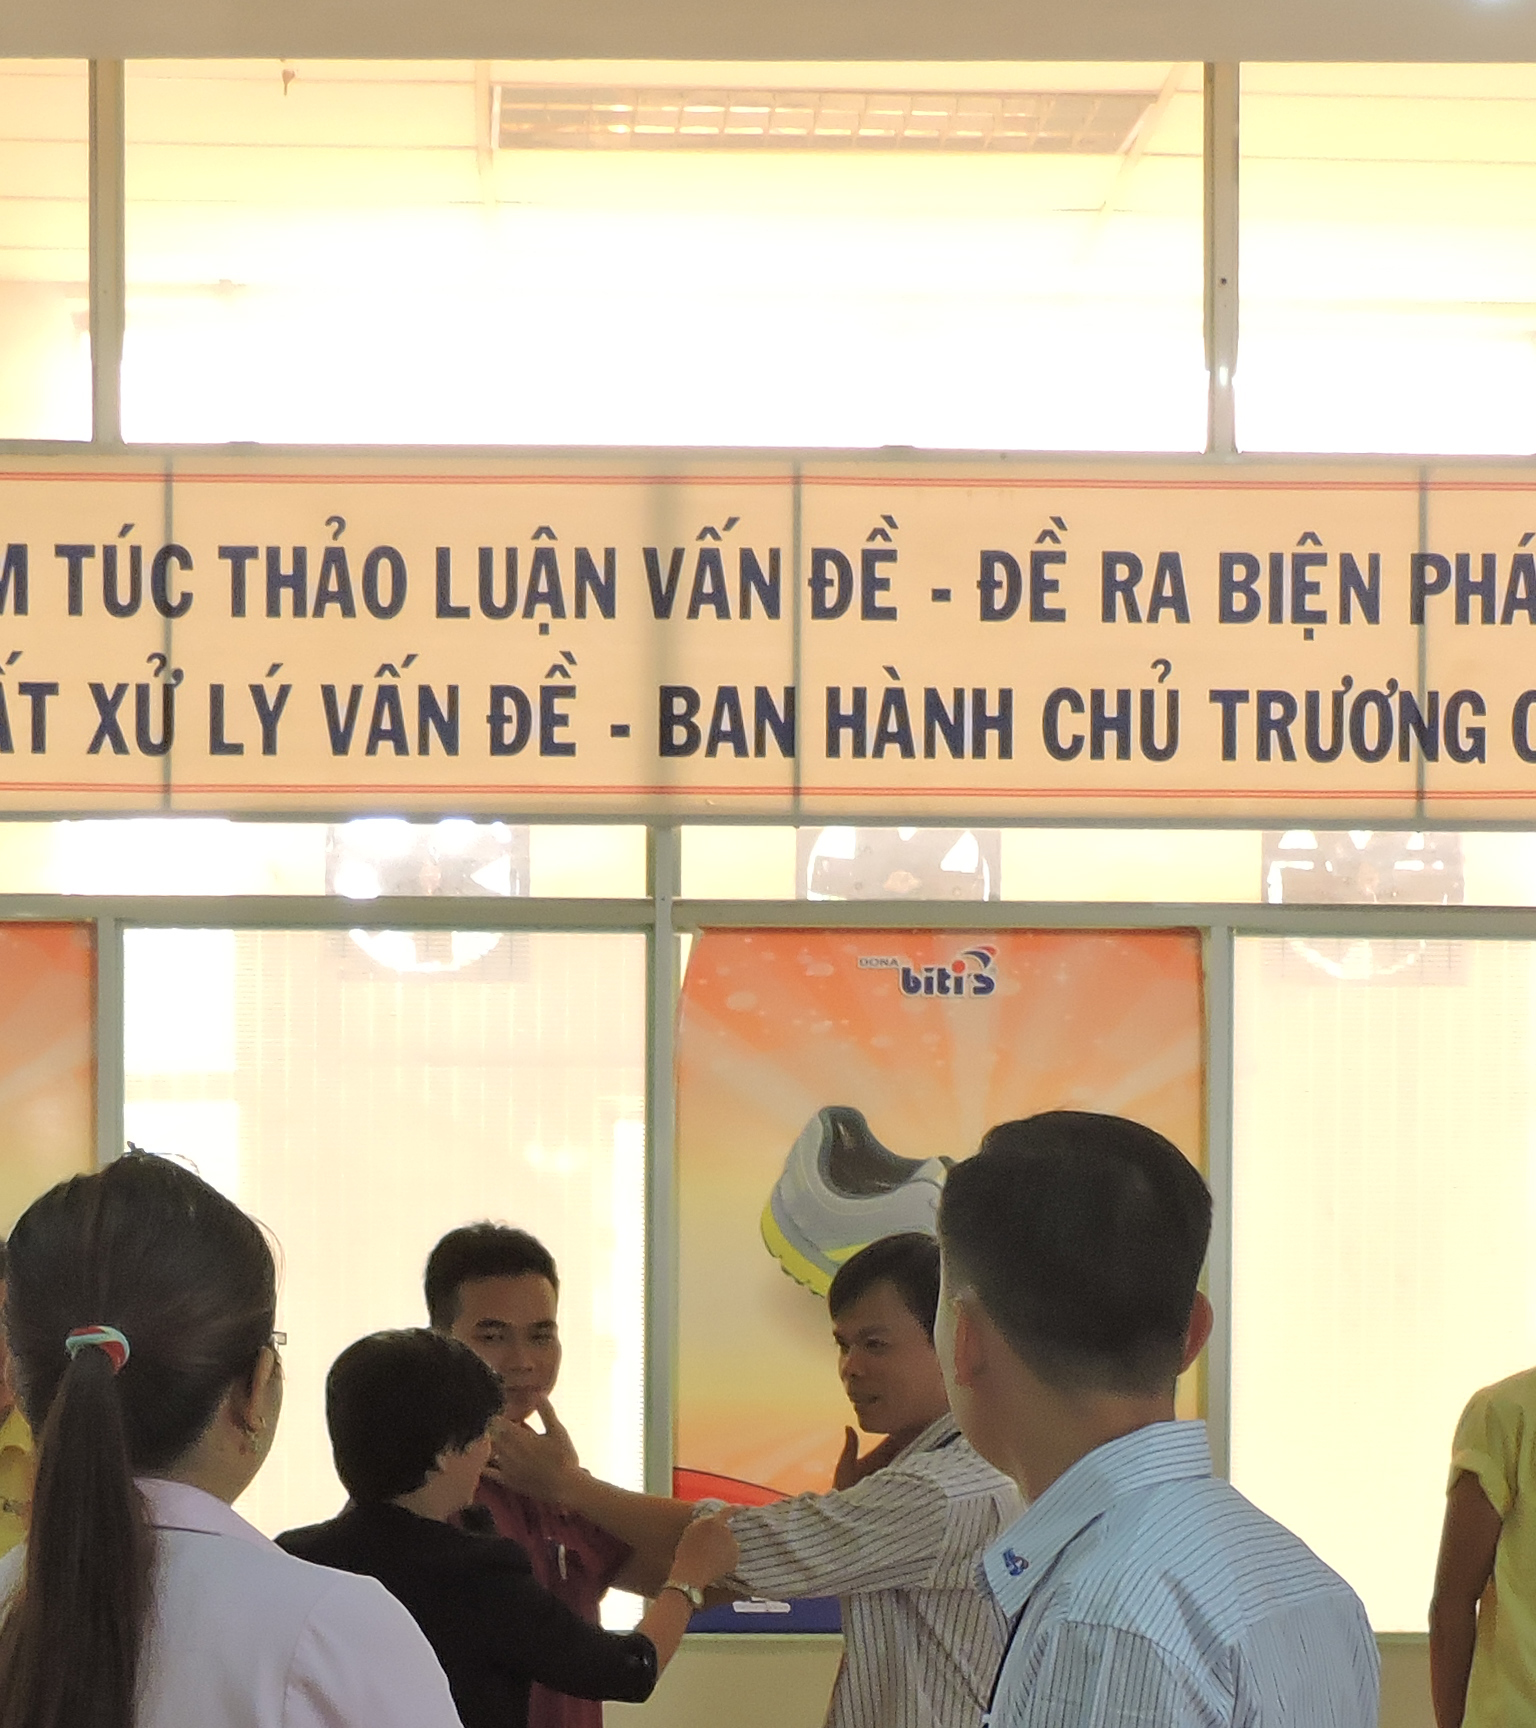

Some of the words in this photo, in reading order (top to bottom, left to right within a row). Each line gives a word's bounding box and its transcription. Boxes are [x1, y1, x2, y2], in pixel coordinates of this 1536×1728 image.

[54, 521, 194, 619] TÚC
[218, 516, 408, 618] THẢO
[436, 525, 617, 634] LUẬN
[644, 516, 782, 619] VẤN
[808, 514, 899, 620] ĐỀ
[976, 515, 1068, 622] ĐỀ
[1102, 552, 1191, 623] RA
[1219, 531, 1381, 641] BIỆN
[88, 652, 184, 757] XỬ
[209, 661, 293, 756] LÝ
[320, 653, 460, 757] VẤN
[486, 651, 578, 757] ĐỀ
[658, 684, 797, 758] BAN
[826, 665, 1014, 760] HÀNH
[1042, 658, 1181, 762] CHỦ
[1209, 673, 1487, 764] TRƯƠNG
